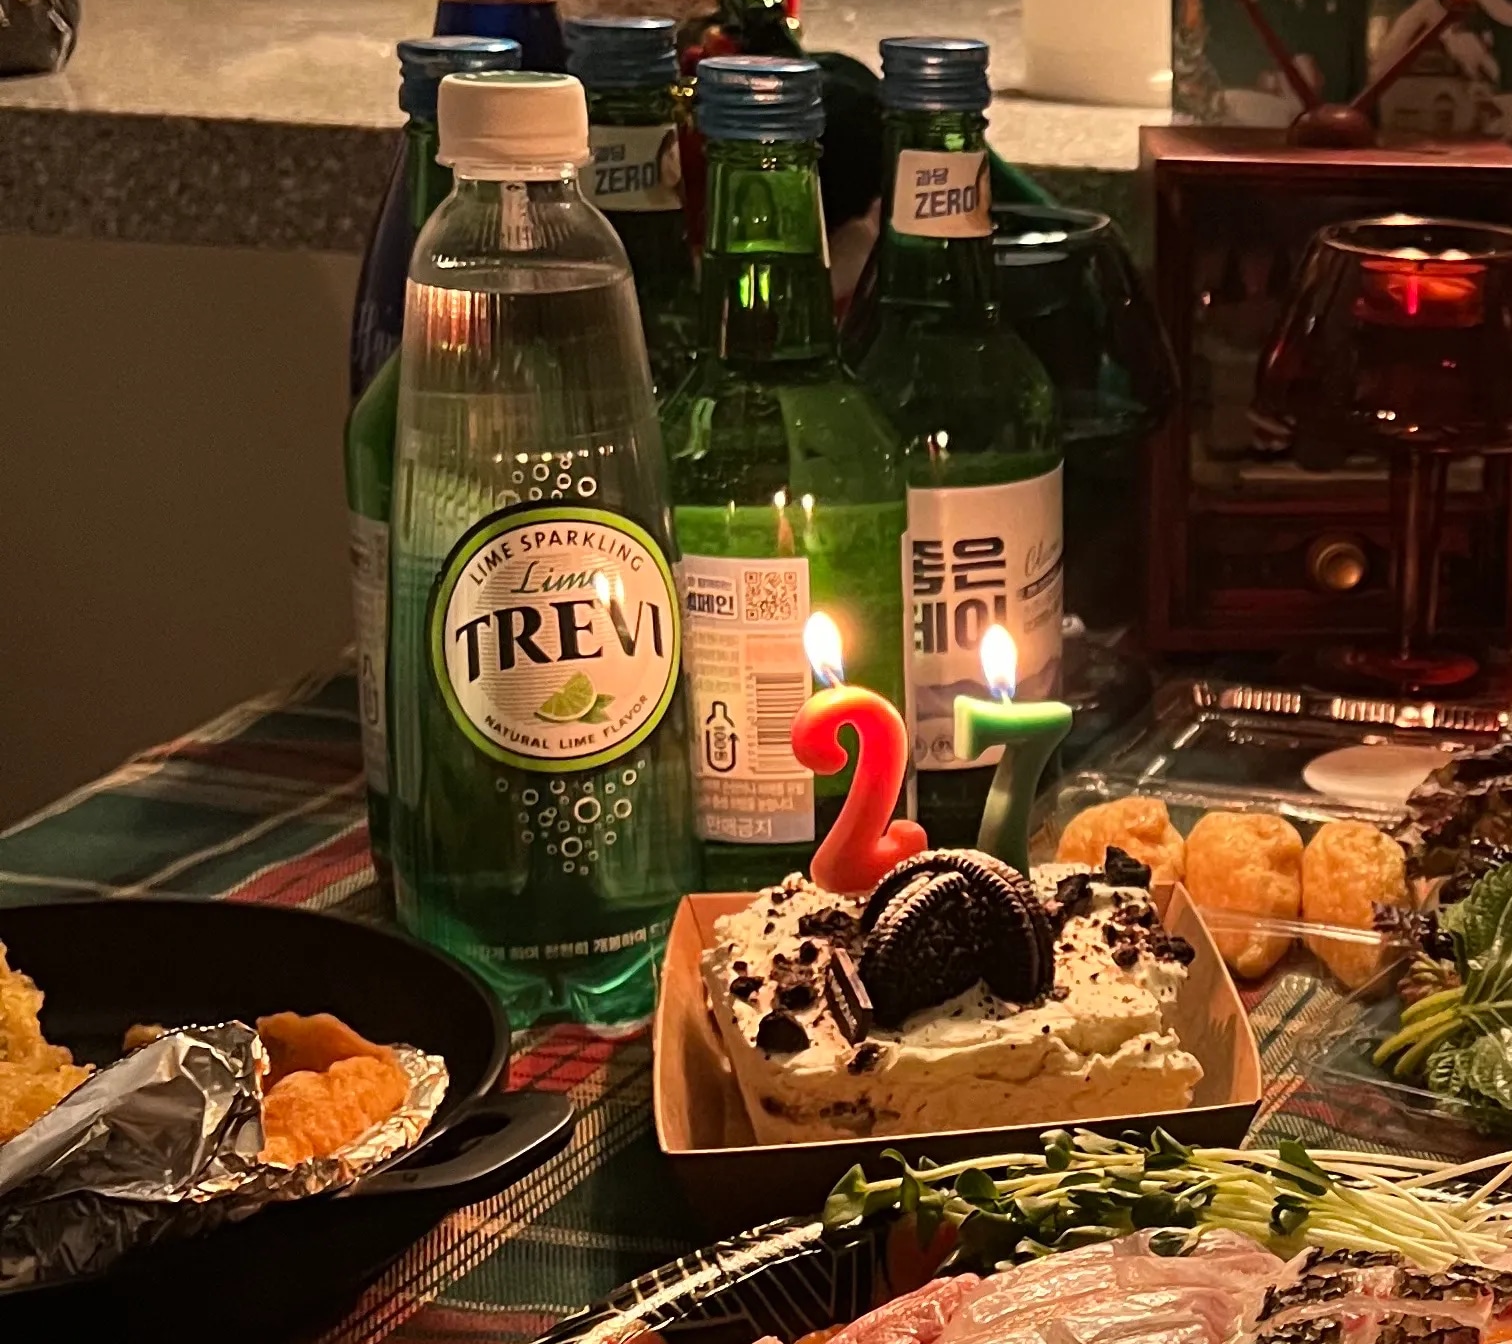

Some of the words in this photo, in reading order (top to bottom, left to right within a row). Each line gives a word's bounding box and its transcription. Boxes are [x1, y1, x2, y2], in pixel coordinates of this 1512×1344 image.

[595, 161, 655, 195] ZERO
[915, 168, 949, 186] 과당
[915, 186, 977, 220] ZERO
[469, 542, 515, 587] LIME
[520, 529, 645, 573] SPARKLING
[455, 598, 664, 684] TREVI
[484, 714, 551, 751] NATURAL
[559, 734, 596, 751] LIME
[602, 694, 649, 739] FLAVOR
